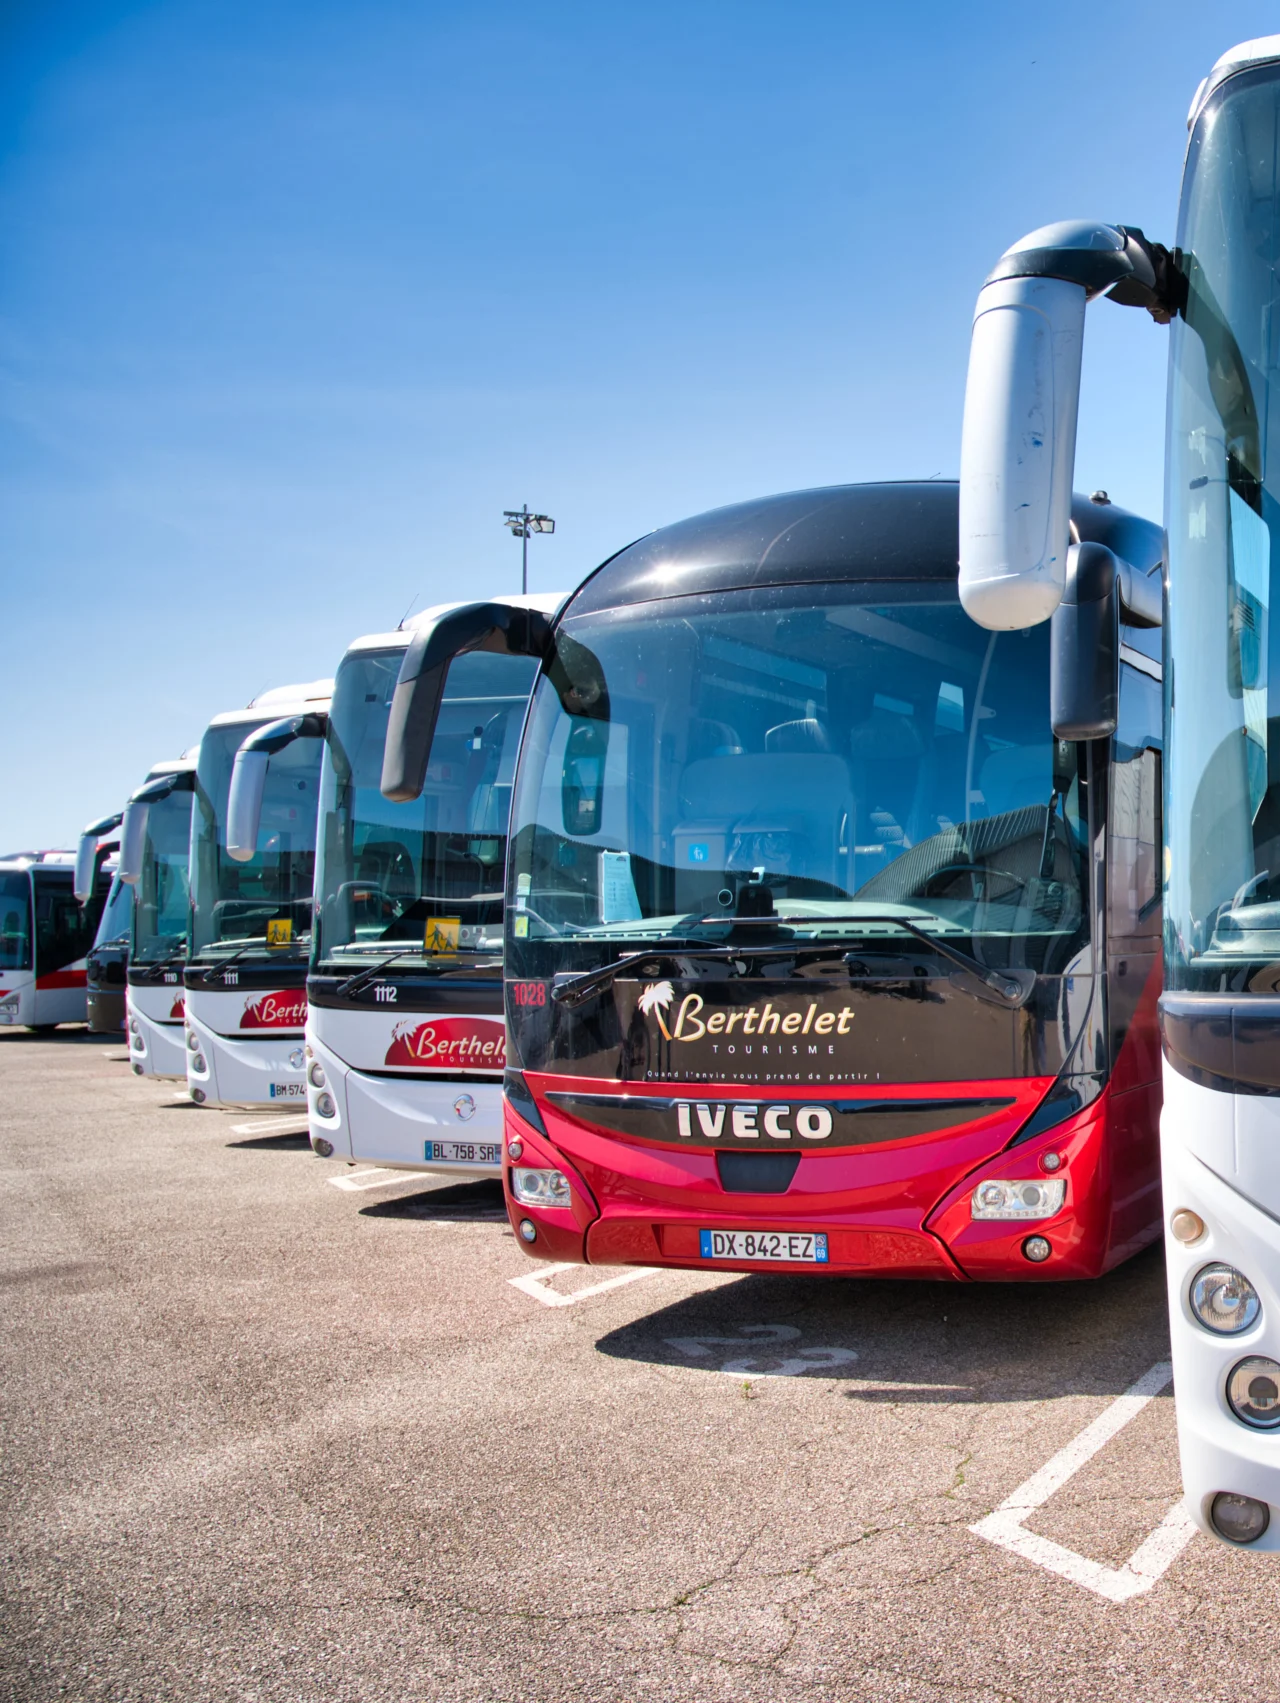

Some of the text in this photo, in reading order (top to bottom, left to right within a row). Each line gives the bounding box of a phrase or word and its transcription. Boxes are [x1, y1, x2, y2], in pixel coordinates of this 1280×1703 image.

[224, 972, 239, 985] 1111
[374, 986, 397, 1002] 1112
[513, 983, 546, 1007] 1028
[673, 993, 855, 1042] Berthelet
[712, 1044, 835, 1055] TOURISME
[647, 1069, 679, 1078] Quand
[685, 1070, 726, 1079] l'envie
[766, 1072, 800, 1081] prend
[808, 1072, 821, 1080] de
[829, 1072, 869, 1081] partir
[676, 1103, 833, 1140] IVECO
[713, 1233, 814, 1259] DX-842-EZ
[816, 1248, 826, 1259] 69
